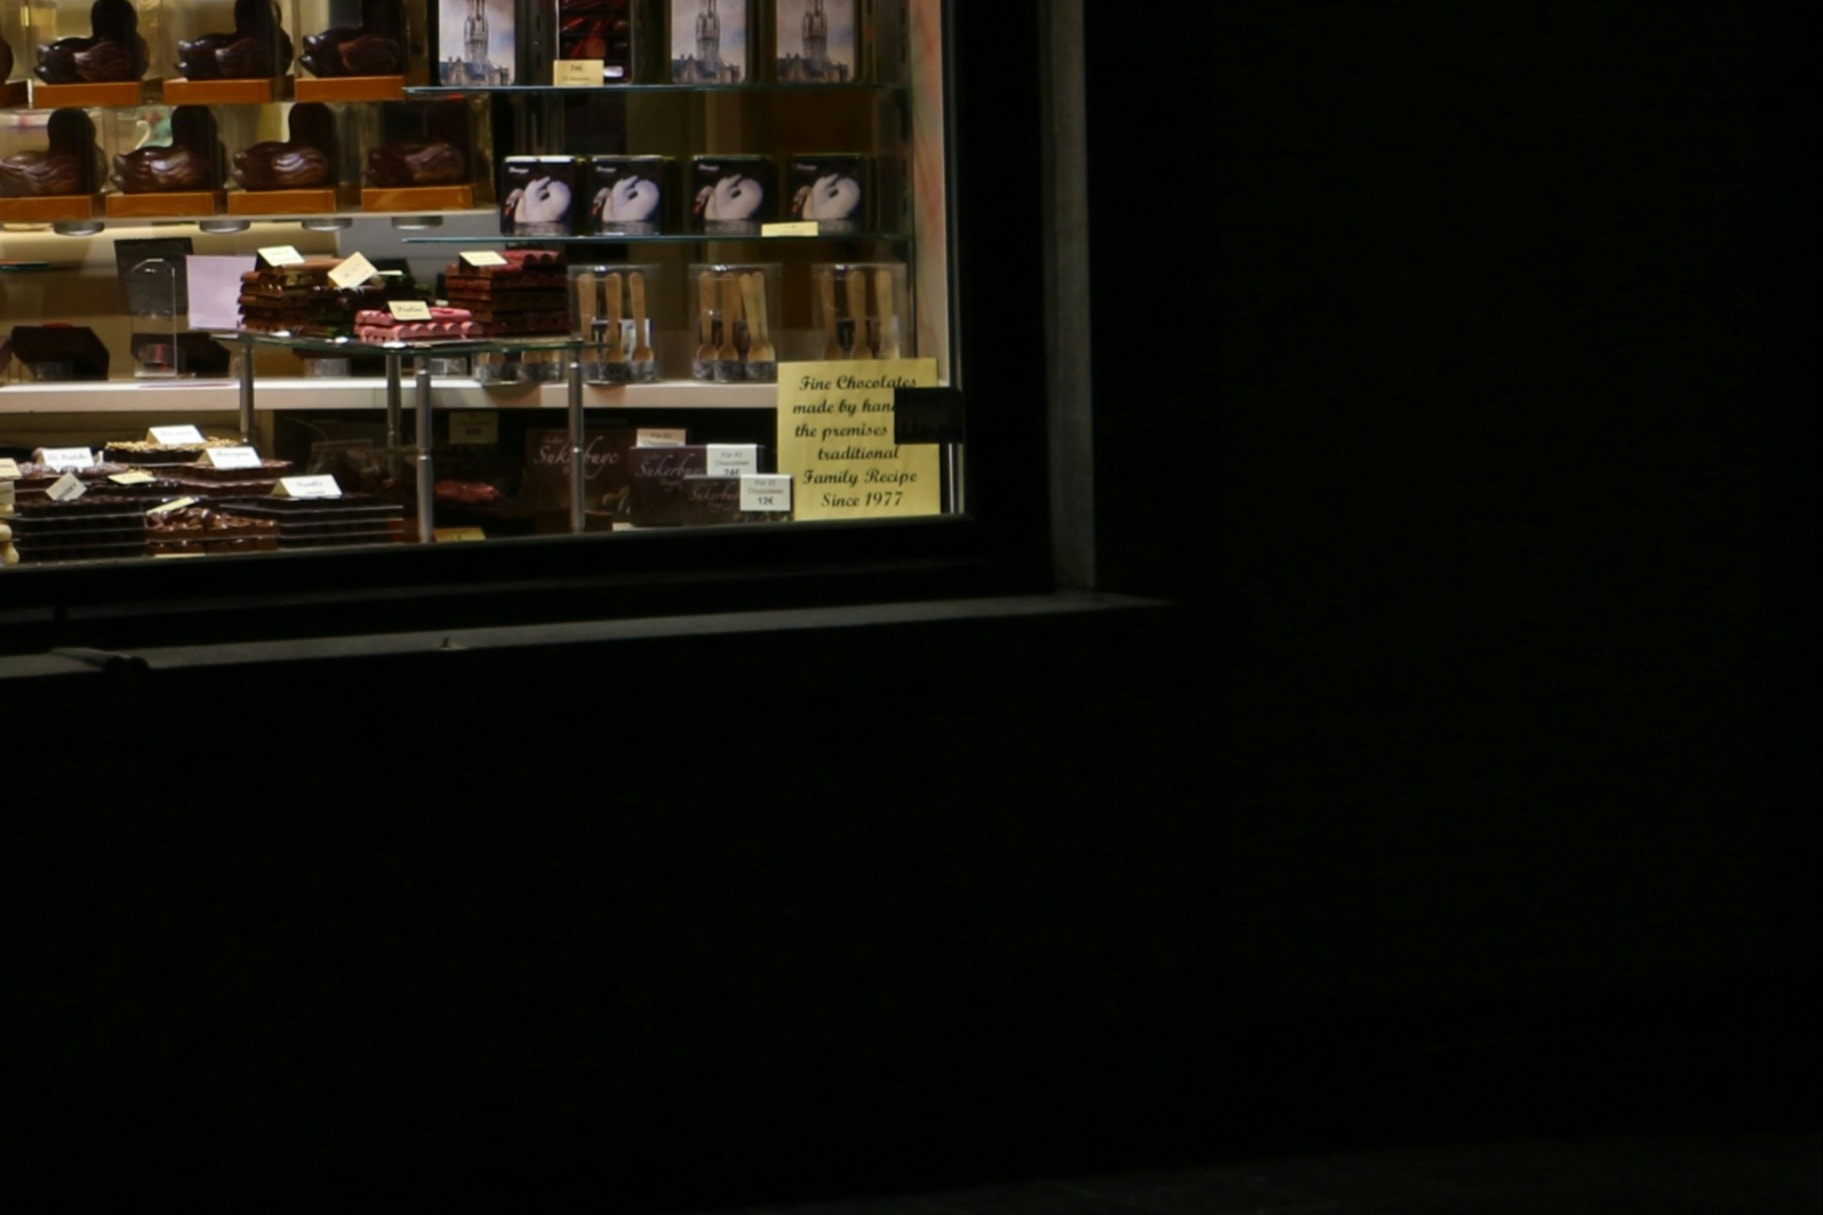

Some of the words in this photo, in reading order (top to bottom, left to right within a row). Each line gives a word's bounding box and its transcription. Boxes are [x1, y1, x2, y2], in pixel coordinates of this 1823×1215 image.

[799, 375, 831, 391] Fine
[836, 375, 917, 390] Chocolates
[793, 401, 834, 415] made
[839, 399, 857, 416] by
[795, 424, 817, 438] the
[821, 424, 888, 441] premises
[818, 445, 900, 461] traditional
[803, 470, 859, 488] Family
[864, 468, 917, 486] Recipe
[821, 493, 860, 508] Since
[865, 491, 904, 507] 1977
